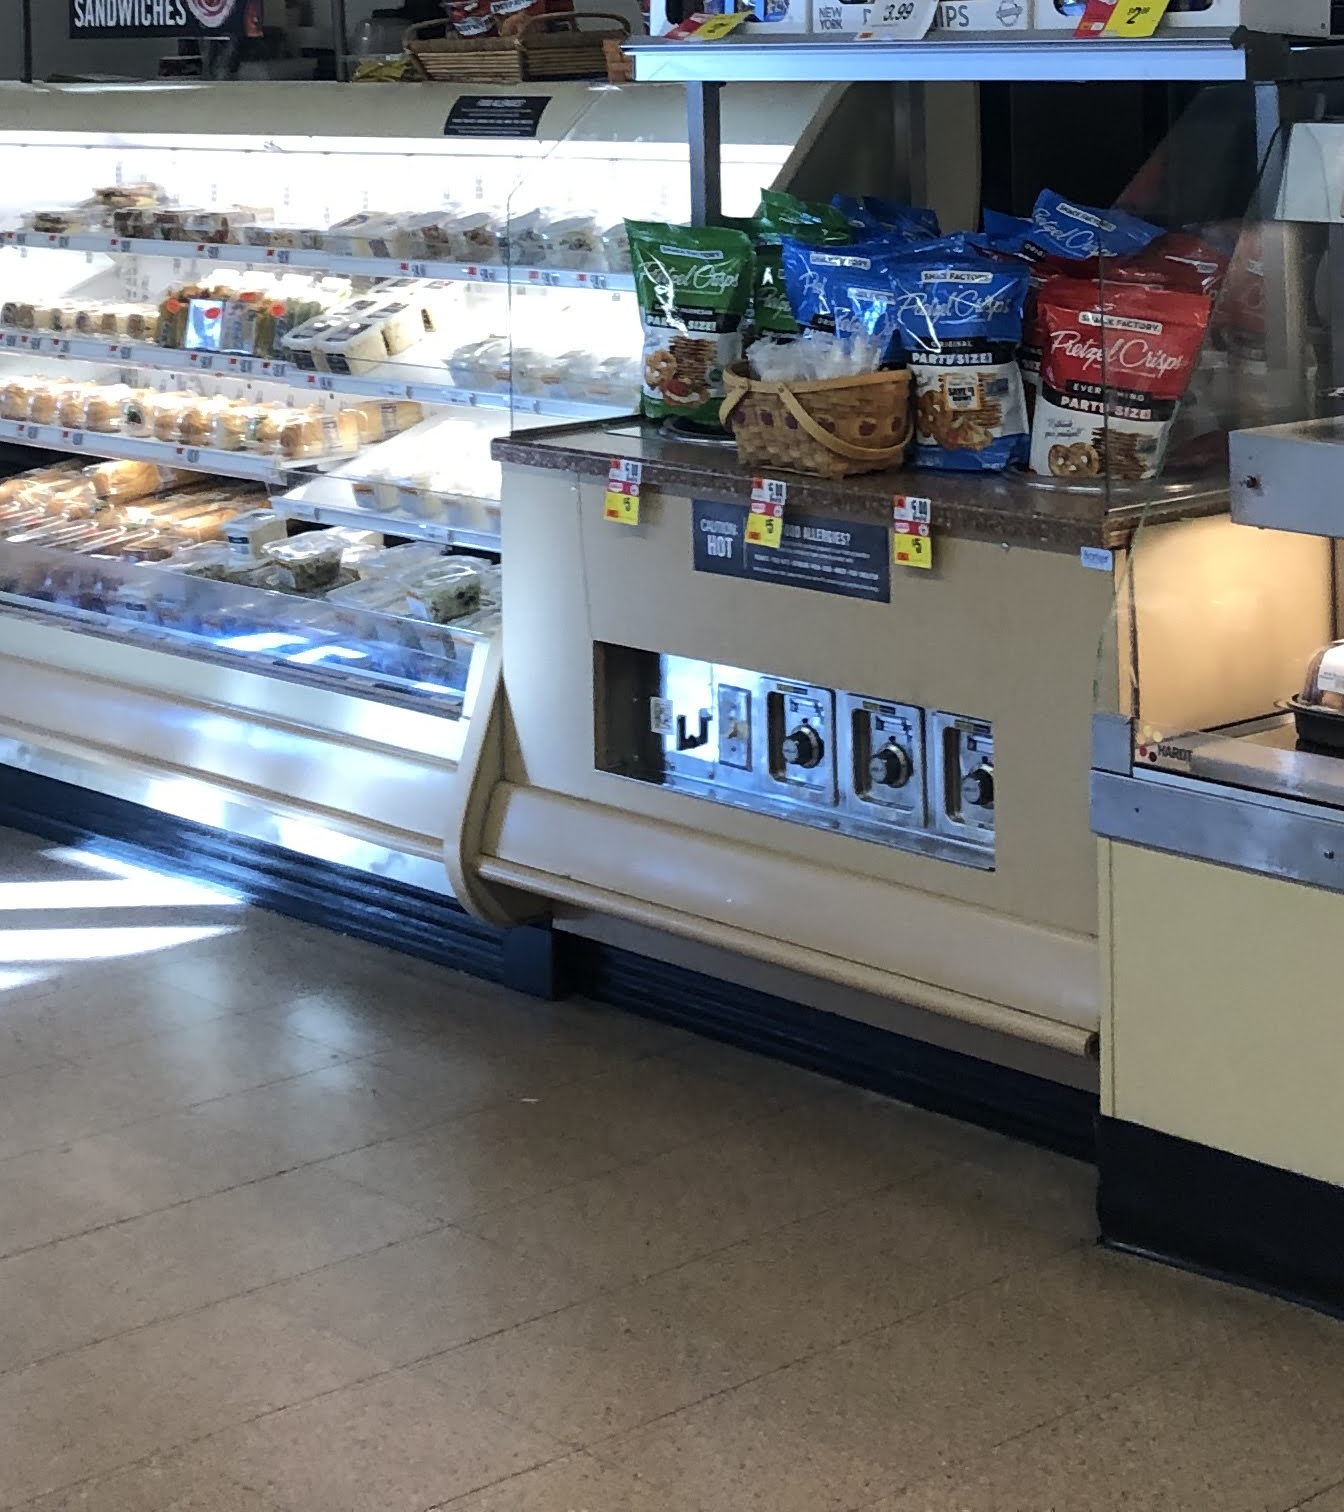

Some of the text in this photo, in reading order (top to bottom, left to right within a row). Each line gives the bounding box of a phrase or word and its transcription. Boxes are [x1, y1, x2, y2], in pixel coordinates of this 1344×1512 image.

[818, 6, 843, 18] NEW
[819, 18, 843, 30] YORK
[1116, 319, 1160, 332] FACTORY
[912, 353, 954, 364] PARTY
[1050, 330, 1184, 378] Pretzel Crisps
[707, 535, 734, 558] HOT
